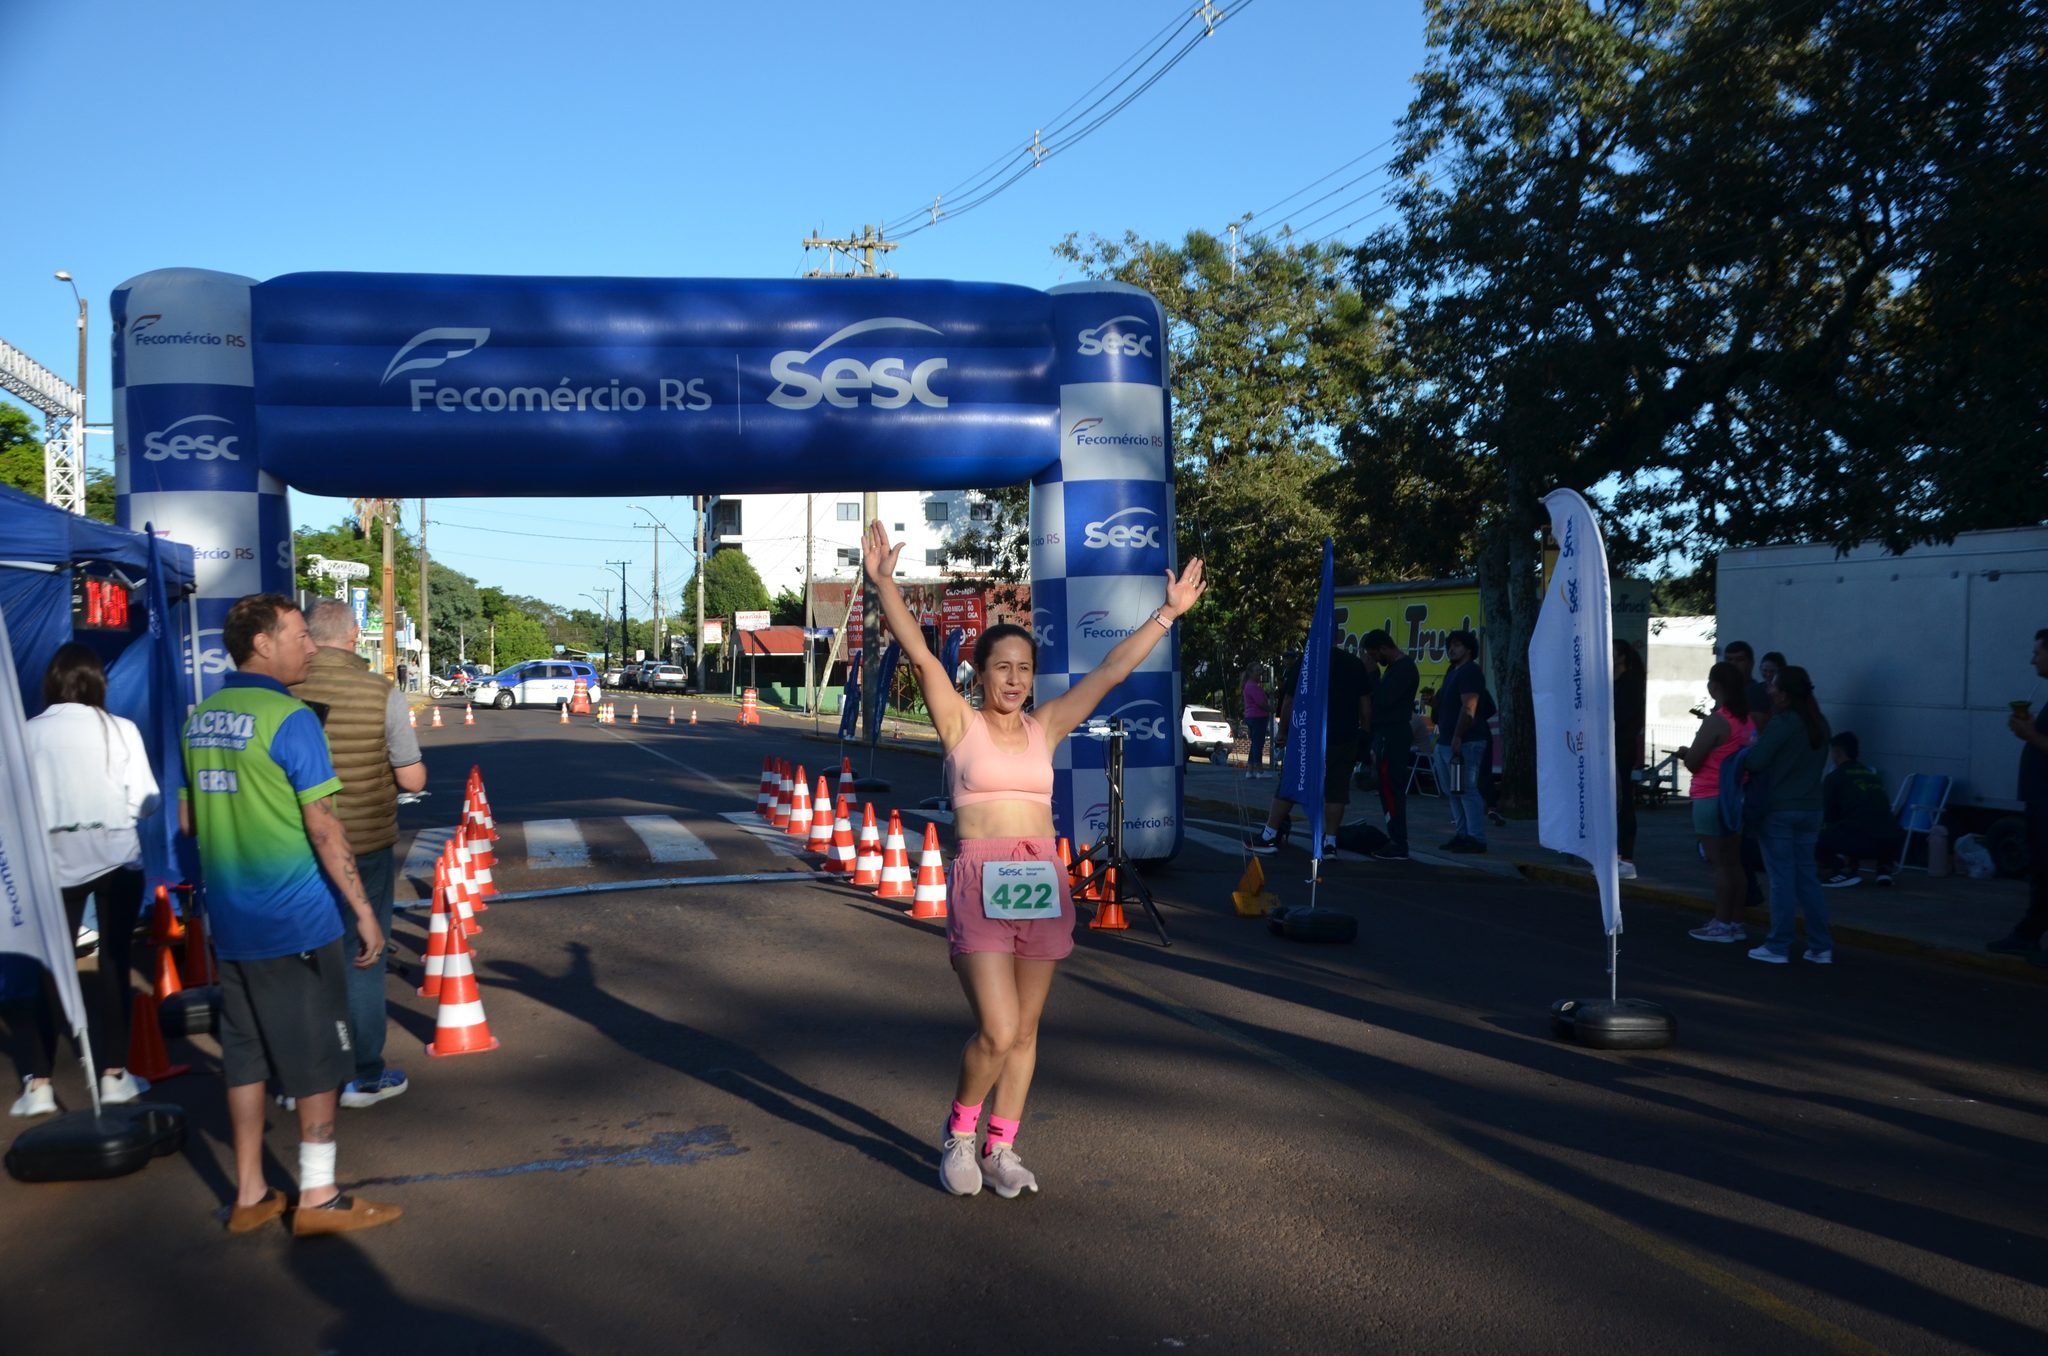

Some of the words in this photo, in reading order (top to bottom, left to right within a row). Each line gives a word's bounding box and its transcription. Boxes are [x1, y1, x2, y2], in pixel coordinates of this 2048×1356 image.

[135, 332, 221, 346] Fecomércio
[226, 334, 246, 347] RS
[1077, 329, 1152, 357] Sesc
[766, 350, 948, 410] Sesc
[411, 377, 646, 412] Fecomércio
[659, 378, 712, 412] RS
[143, 431, 240, 462] Sesc
[1077, 433, 1149, 446] Fecomércio
[1151, 435, 1163, 447] RS
[1046, 533, 1060, 544] RS
[1083, 521, 1159, 549] Sesc
[194, 547, 230, 560] ércio
[235, 547, 254, 560] RS
[1033, 624, 1054, 647] sc
[1084, 626, 1140, 638] Fecomé
[1405, 603, 1479, 663] Tru
[1573, 635, 1583, 710] Sindicatos
[1299, 711, 1307, 726] RS
[1577, 755, 1587, 840] Fecomércio
[1090, 817, 1160, 830] Femércio
[1164, 816, 1175, 827] RS
[998, 867, 1023, 877] Sesc
[991, 883, 1053, 910] 422
